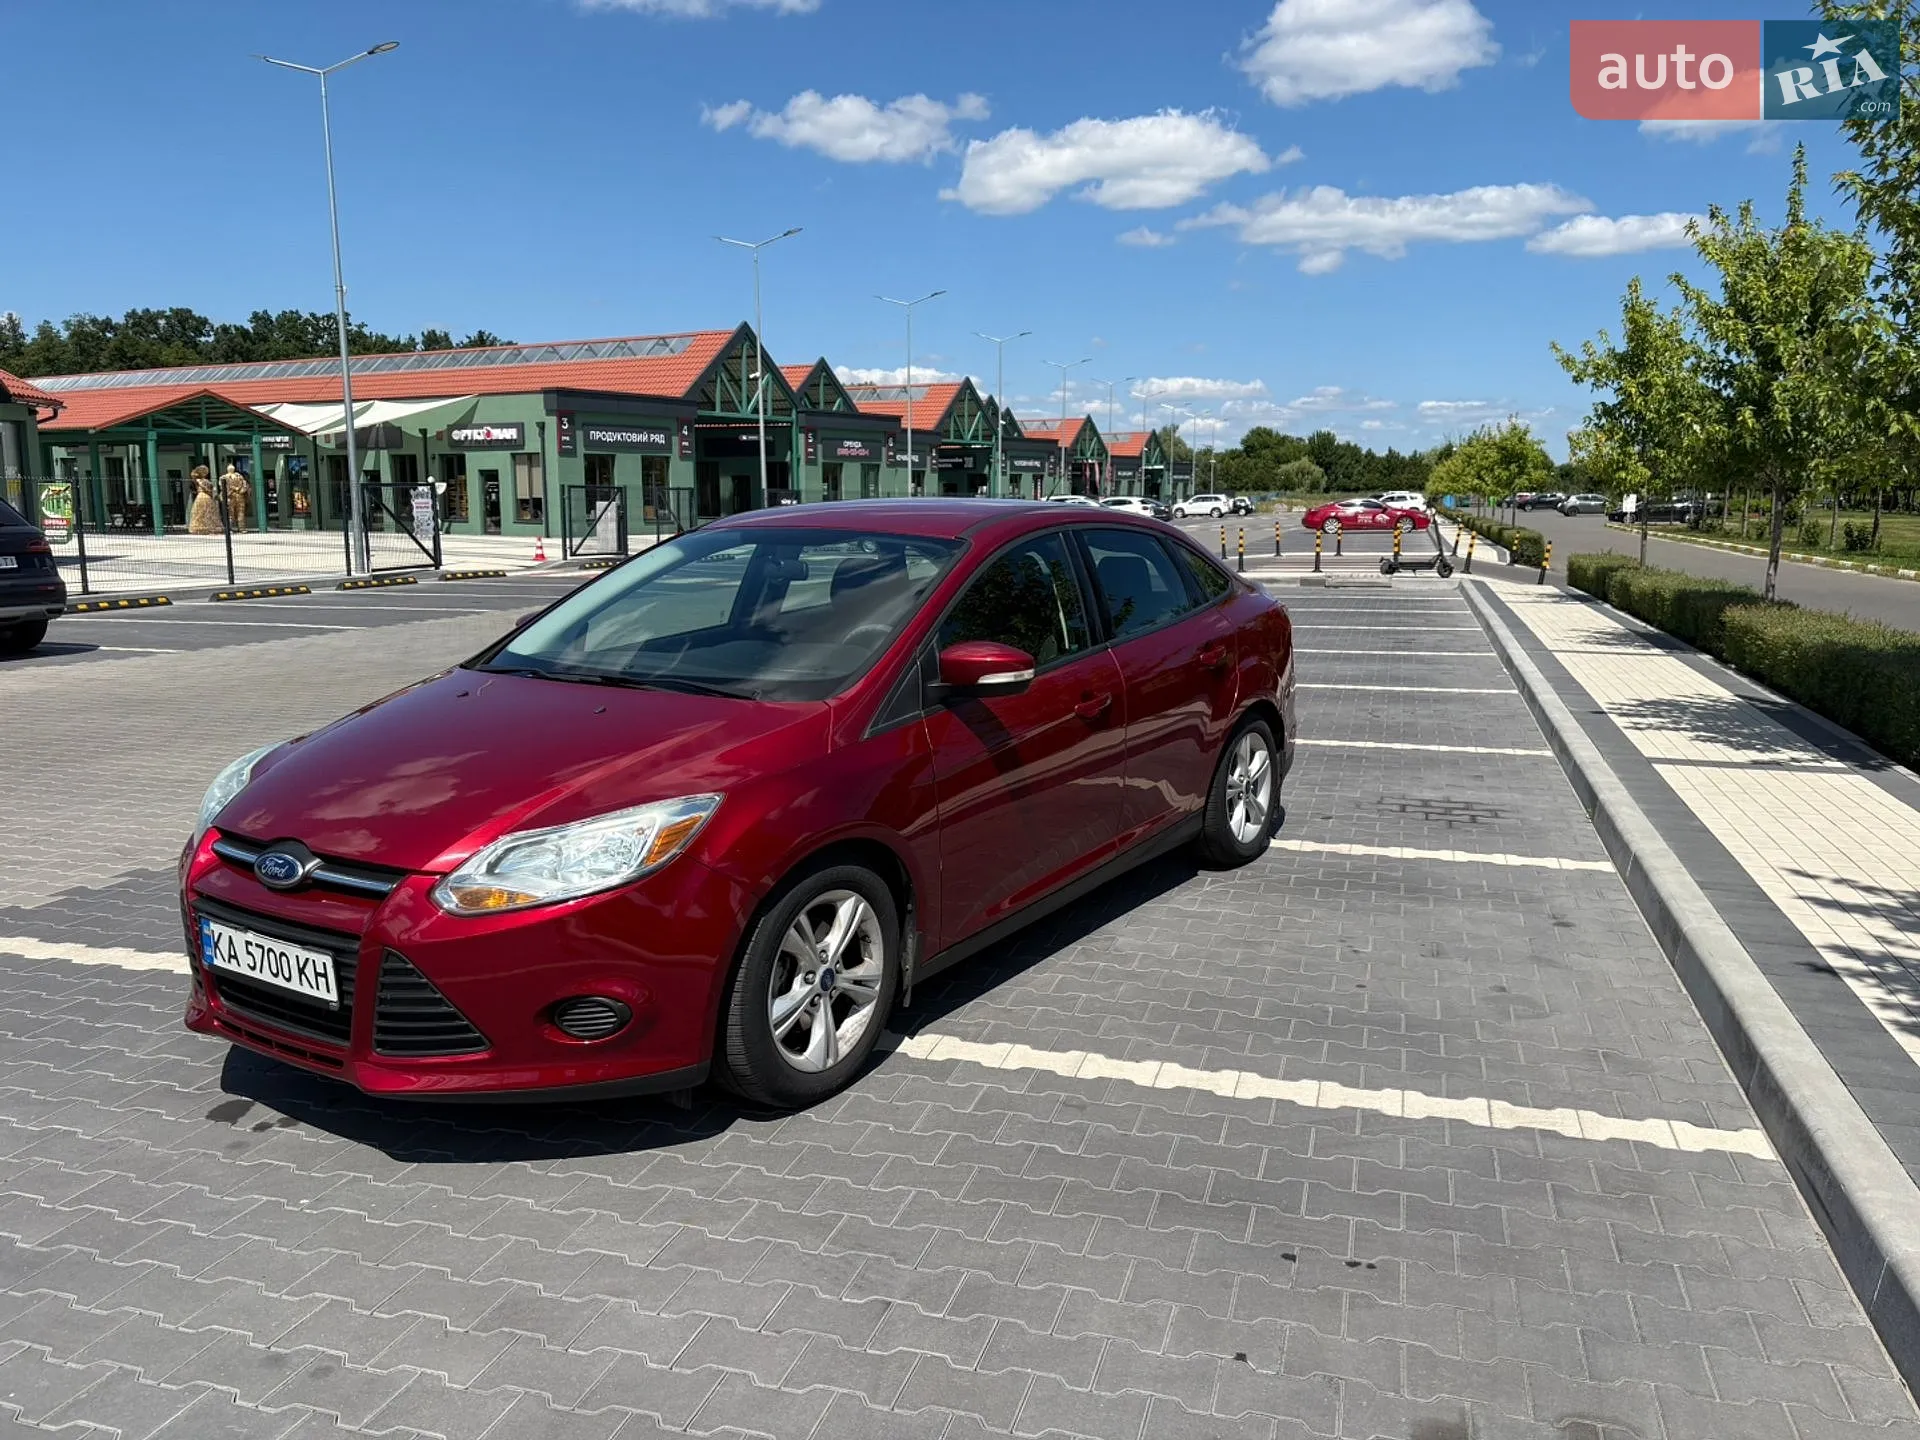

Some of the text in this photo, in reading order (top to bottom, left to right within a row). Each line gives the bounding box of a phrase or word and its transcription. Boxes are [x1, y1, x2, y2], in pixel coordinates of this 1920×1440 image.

[561, 417, 569, 430] 3
[682, 425, 689, 437] 4
[589, 430, 666, 445] ПРОДУКТОВИЙ РЯД
[261, 857, 289, 878] Ford
[211, 929, 331, 994] KA 5700 KH
